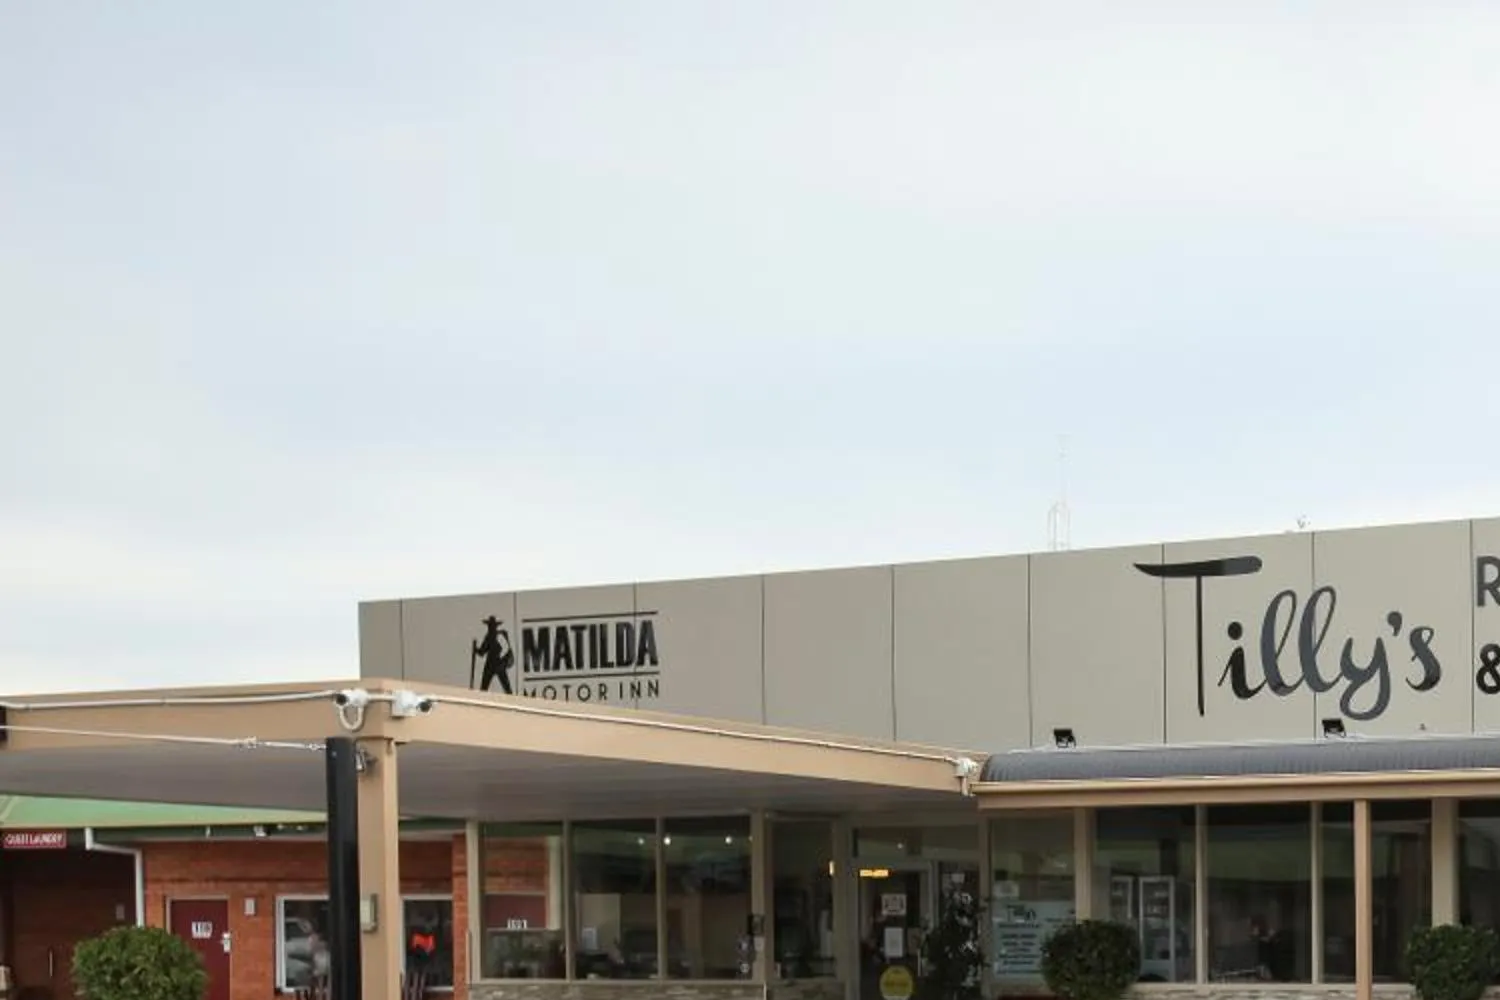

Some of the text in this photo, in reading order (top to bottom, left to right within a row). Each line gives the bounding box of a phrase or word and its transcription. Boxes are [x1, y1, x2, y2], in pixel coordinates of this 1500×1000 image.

[522, 620, 658, 672] MATILDA
[1133, 556, 1442, 720] Tilly's
[619, 680, 659, 698] INN
